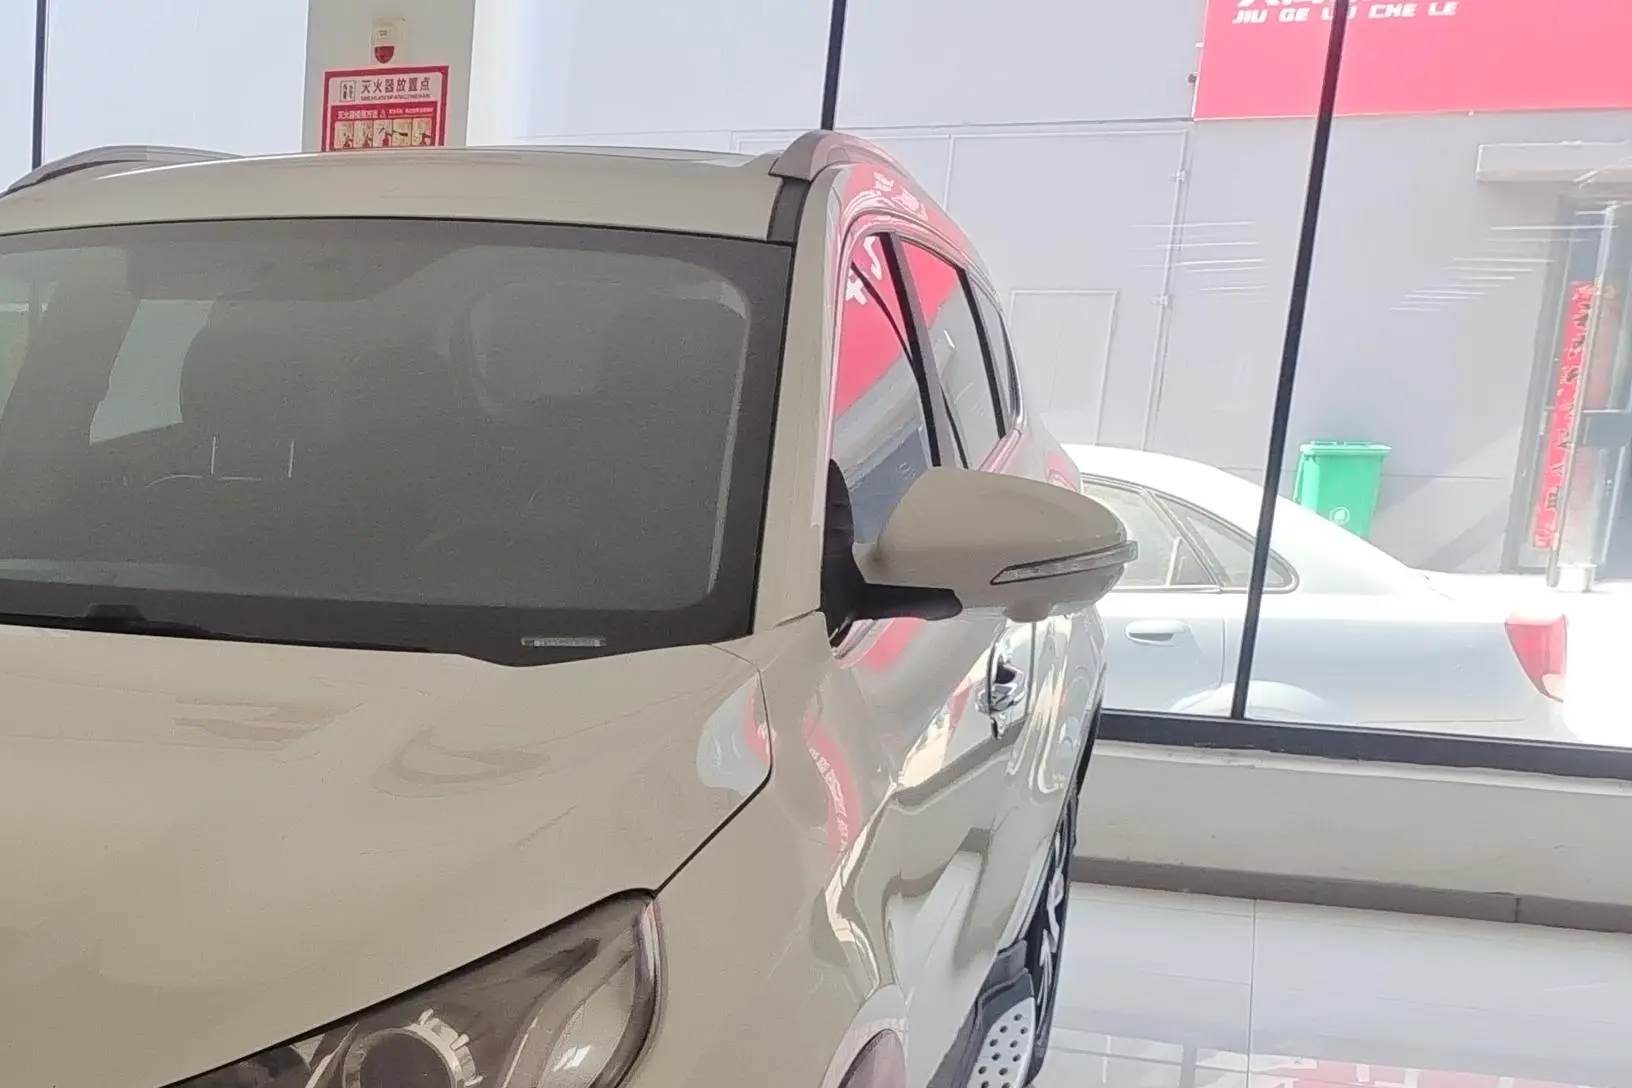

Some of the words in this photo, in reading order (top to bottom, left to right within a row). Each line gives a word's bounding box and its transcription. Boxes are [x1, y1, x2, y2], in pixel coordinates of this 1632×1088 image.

[1232, 9, 1268, 24] JIU
[1279, 7, 1311, 23] GE
[1367, 3, 1417, 19] CHE
[1428, 1, 1460, 16] LE
[361, 77, 431, 94] 灭火器放置点
